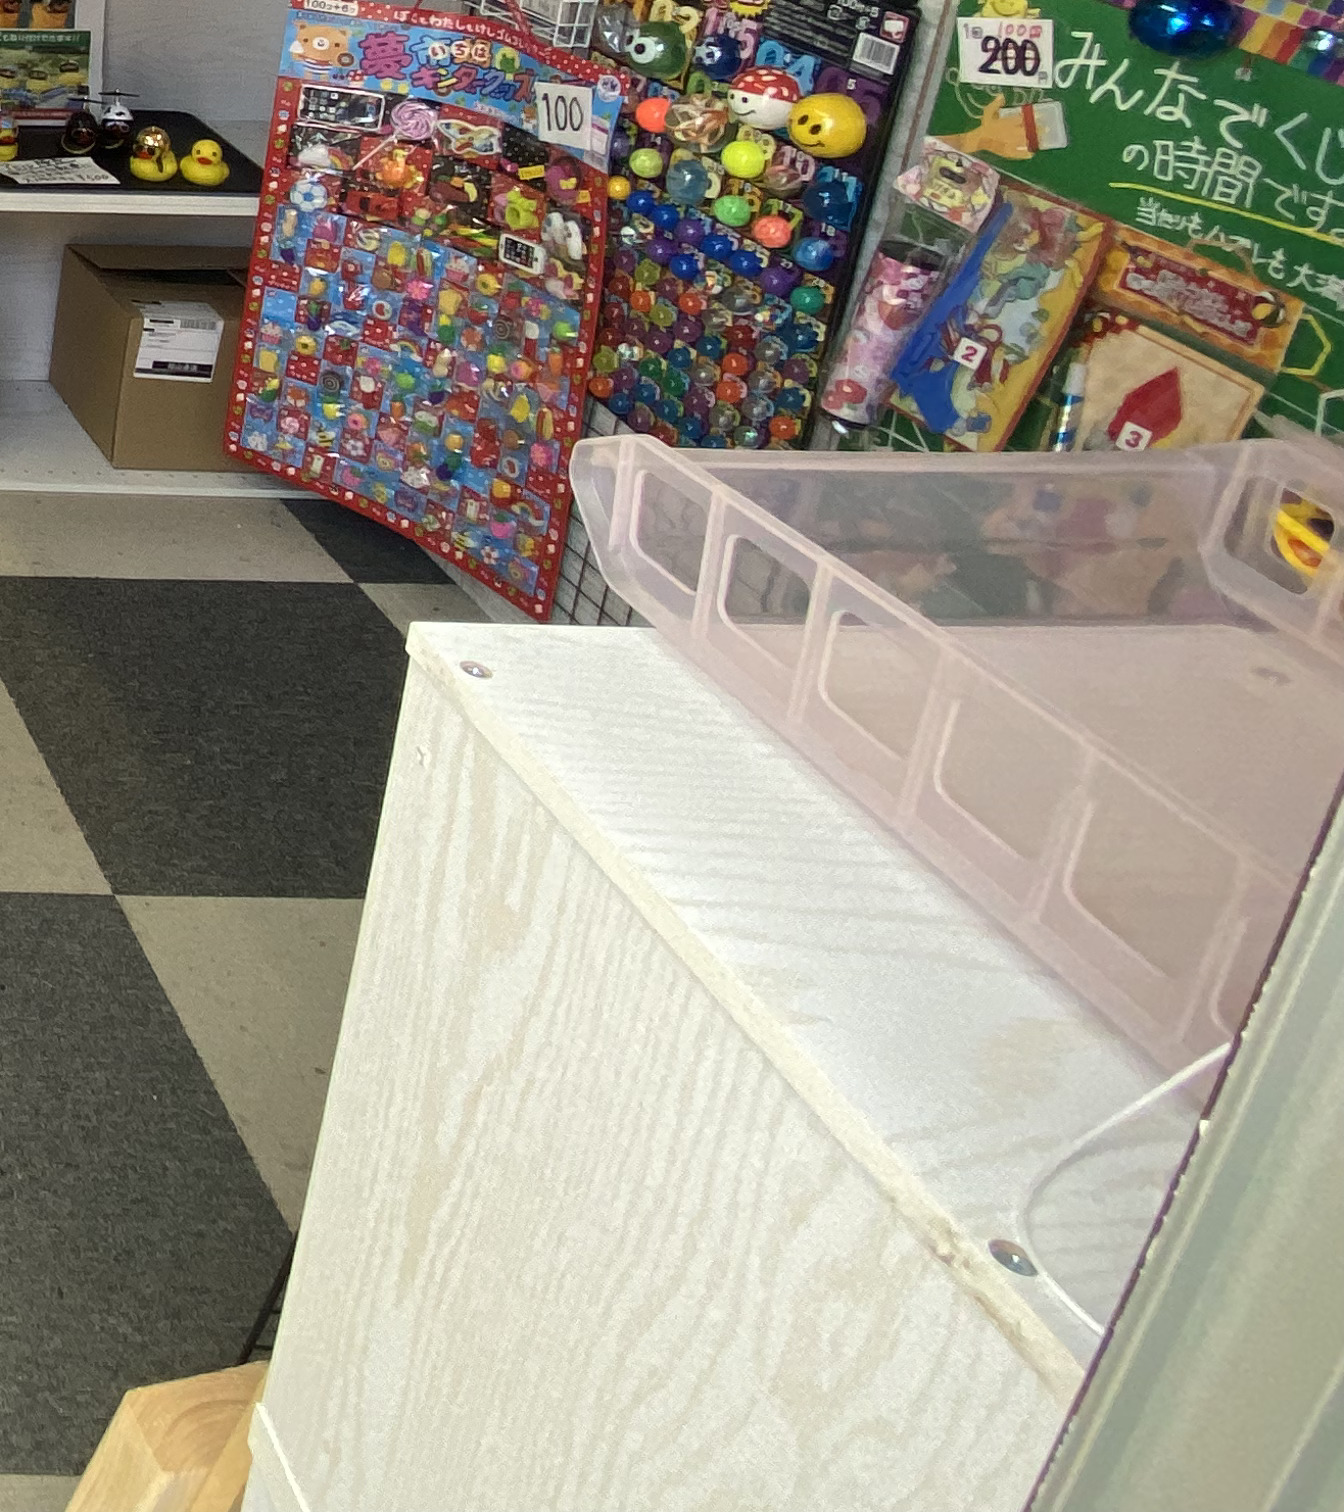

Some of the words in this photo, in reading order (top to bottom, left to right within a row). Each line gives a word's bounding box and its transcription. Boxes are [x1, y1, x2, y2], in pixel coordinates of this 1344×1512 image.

[541, 92, 584, 133] 100
[1054, 31, 1344, 186] みんなでくじ
